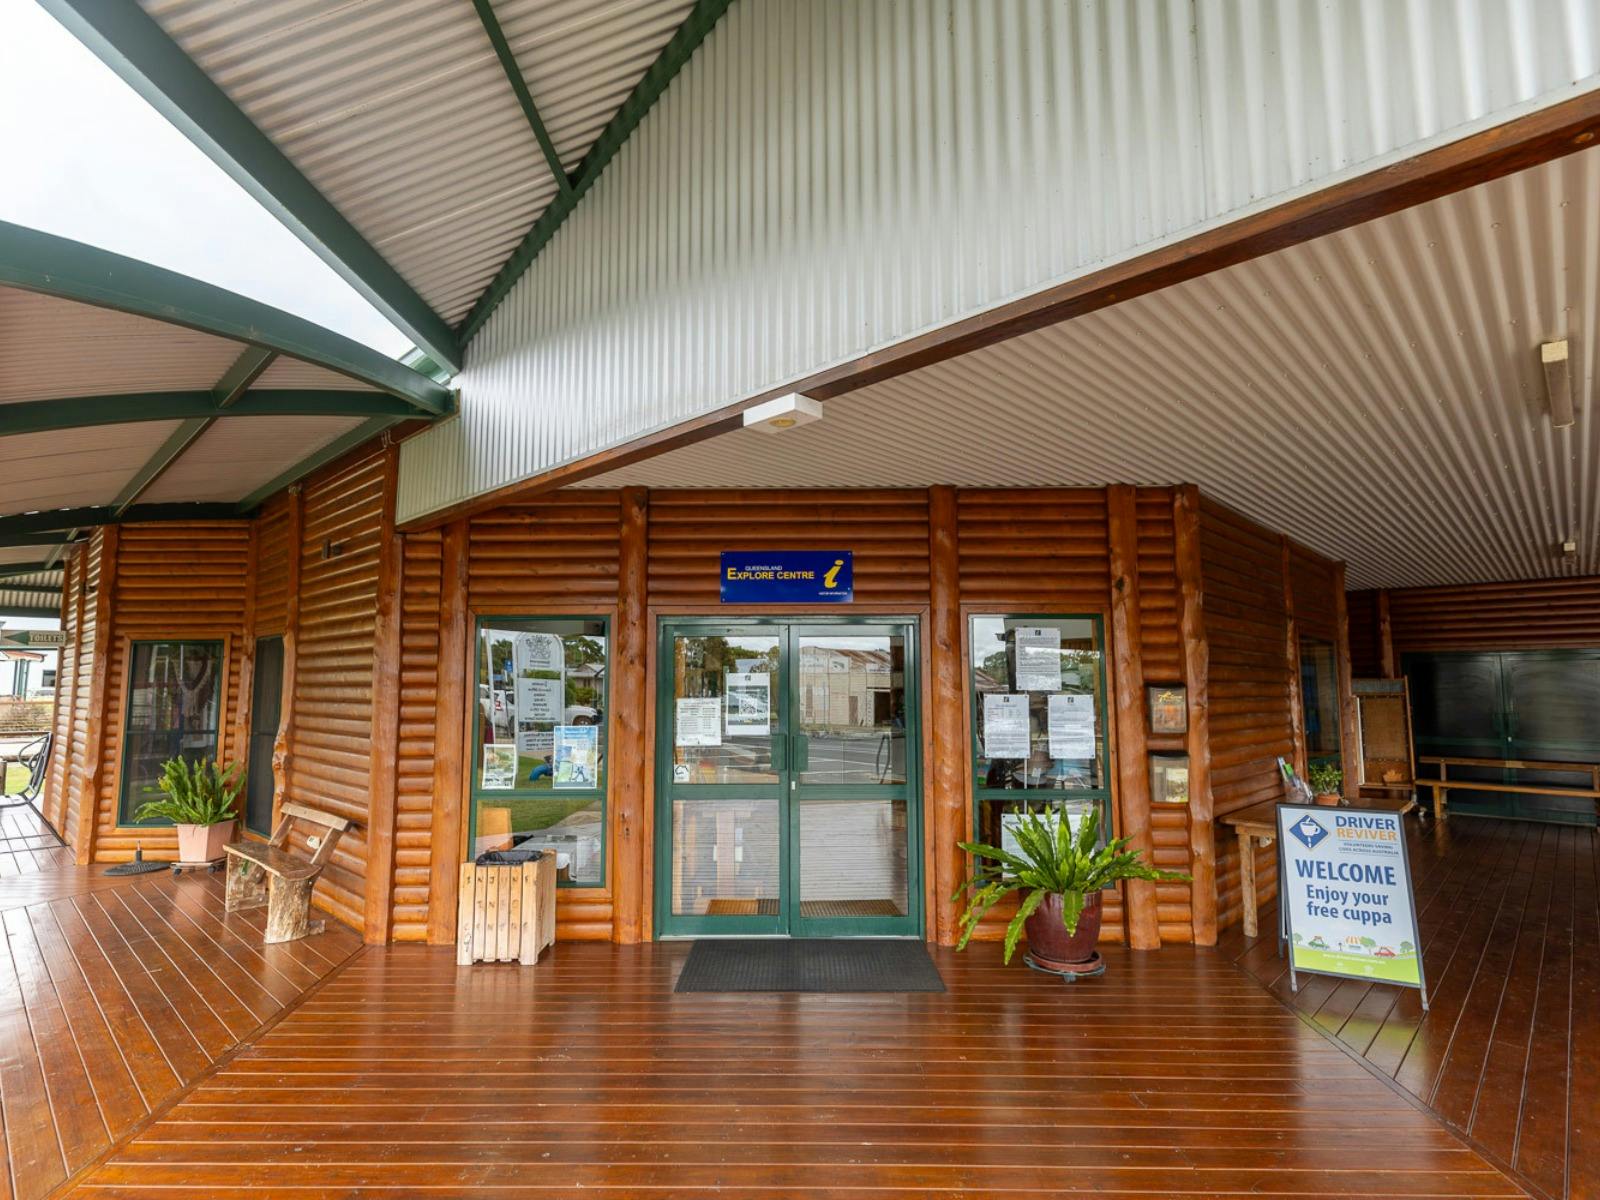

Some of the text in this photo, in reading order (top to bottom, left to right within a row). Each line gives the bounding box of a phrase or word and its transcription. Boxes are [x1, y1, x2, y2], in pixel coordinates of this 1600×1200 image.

[727, 567, 815, 580] EXPLORE CENTRE
[1336, 815, 1396, 831] DRIVER
[1337, 827, 1397, 841] REVIVER
[1295, 858, 1397, 886] WELCOME
[1306, 884, 1389, 907] Enjoy your
[1306, 901, 1392, 926] free cuppa
